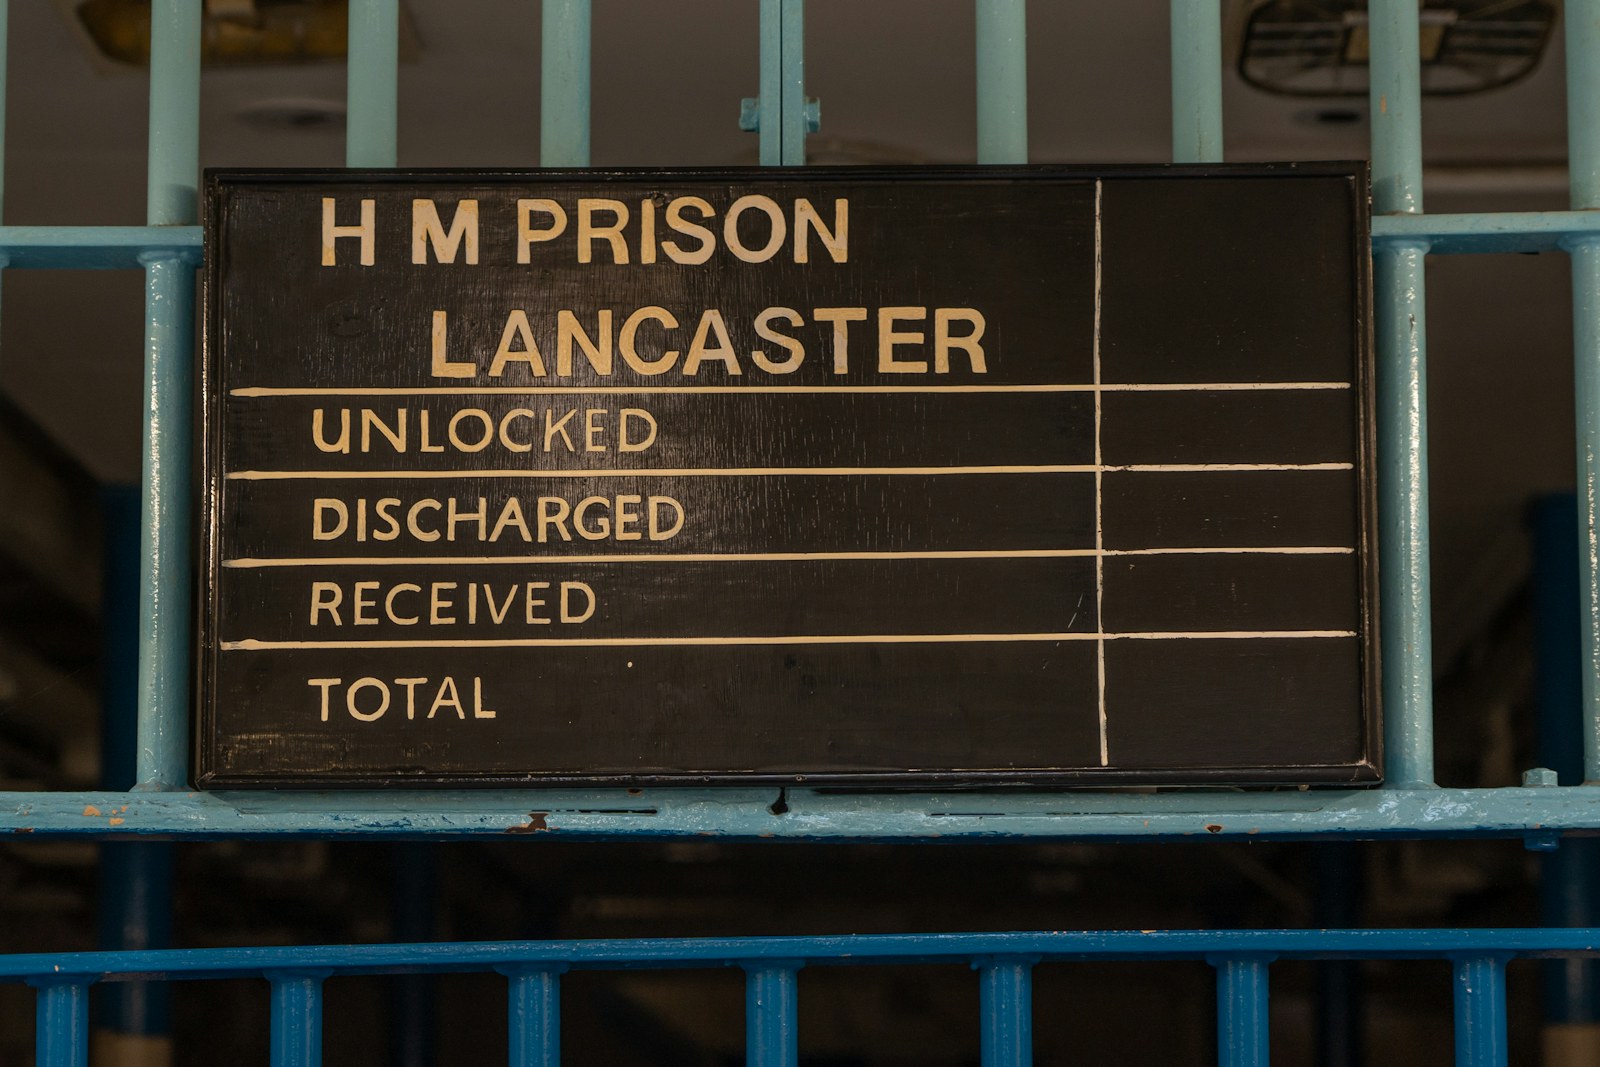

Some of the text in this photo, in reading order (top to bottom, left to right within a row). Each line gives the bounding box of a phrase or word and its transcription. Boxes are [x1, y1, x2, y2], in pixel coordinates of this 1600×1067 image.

[321, 194, 849, 267] H M PRISON
[430, 305, 989, 379] LANCASTER
[312, 407, 658, 455] UNLOCKED
[312, 493, 685, 543] DISCHARGED
[310, 580, 596, 627] RECEIVED
[307, 676, 497, 722] TOTAL
